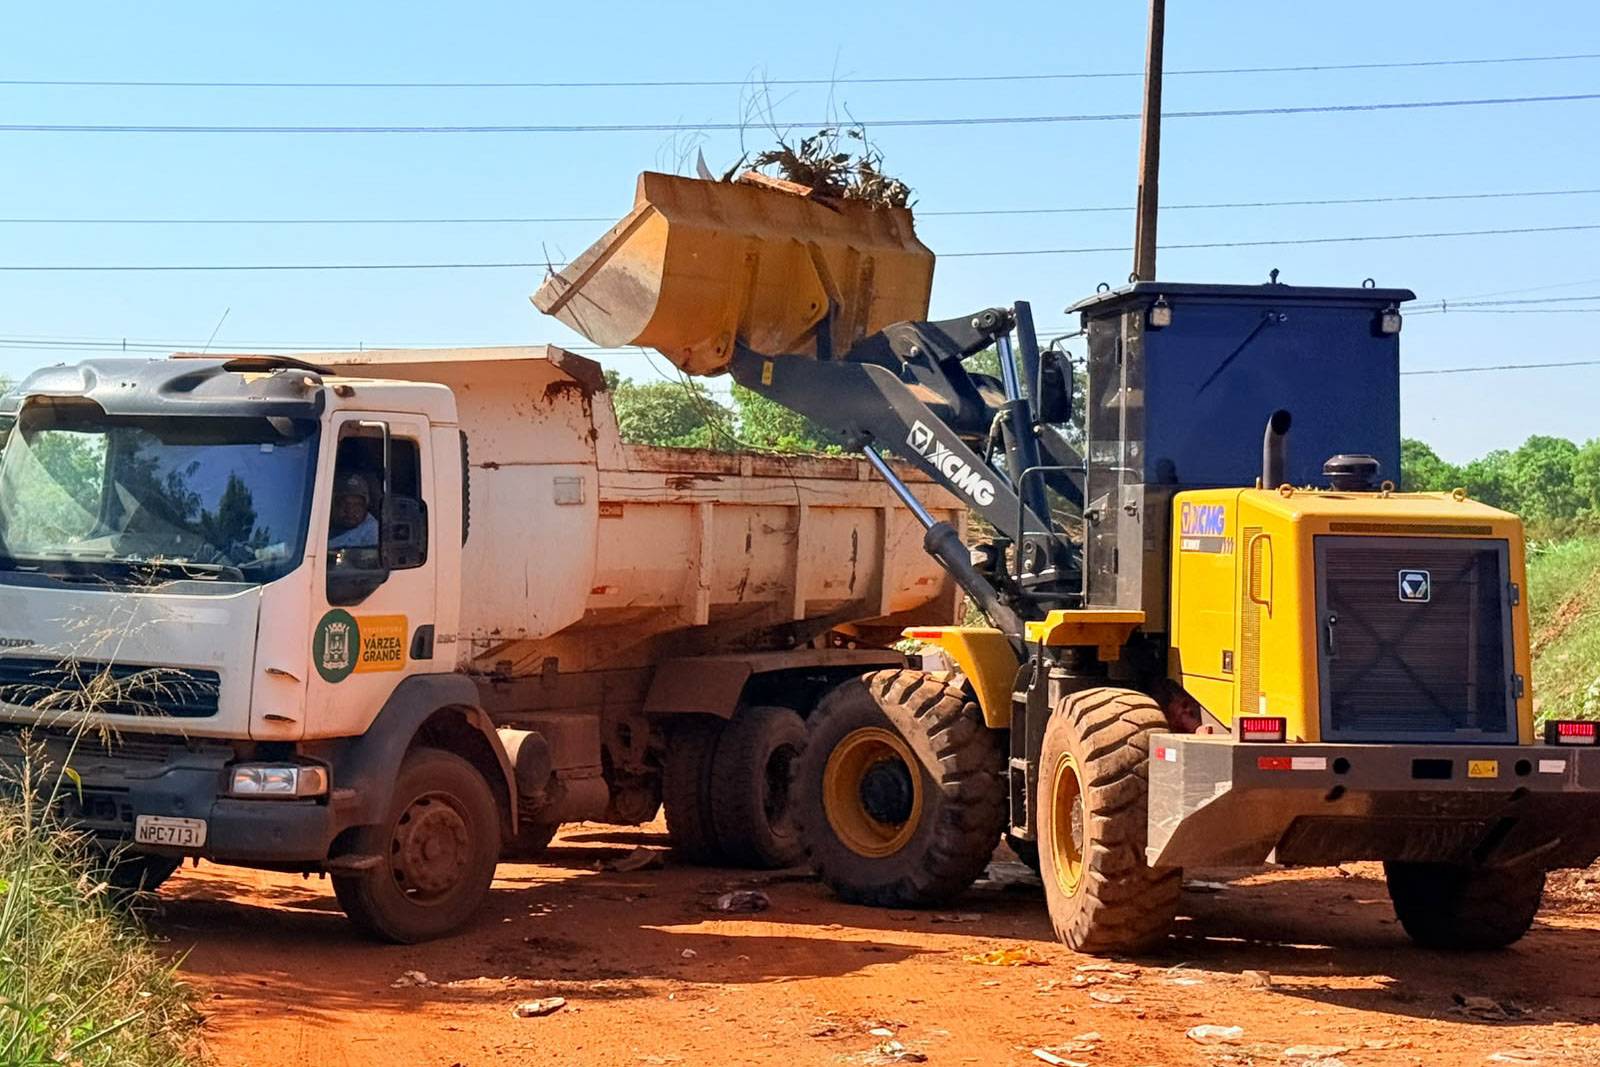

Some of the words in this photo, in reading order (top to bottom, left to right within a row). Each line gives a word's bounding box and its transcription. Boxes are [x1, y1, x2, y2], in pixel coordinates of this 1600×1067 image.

[924, 440, 996, 506] XCMG
[1190, 505, 1225, 535] XCMG
[363, 634, 401, 649] VÁRZEA
[363, 649, 401, 662] GRANDE
